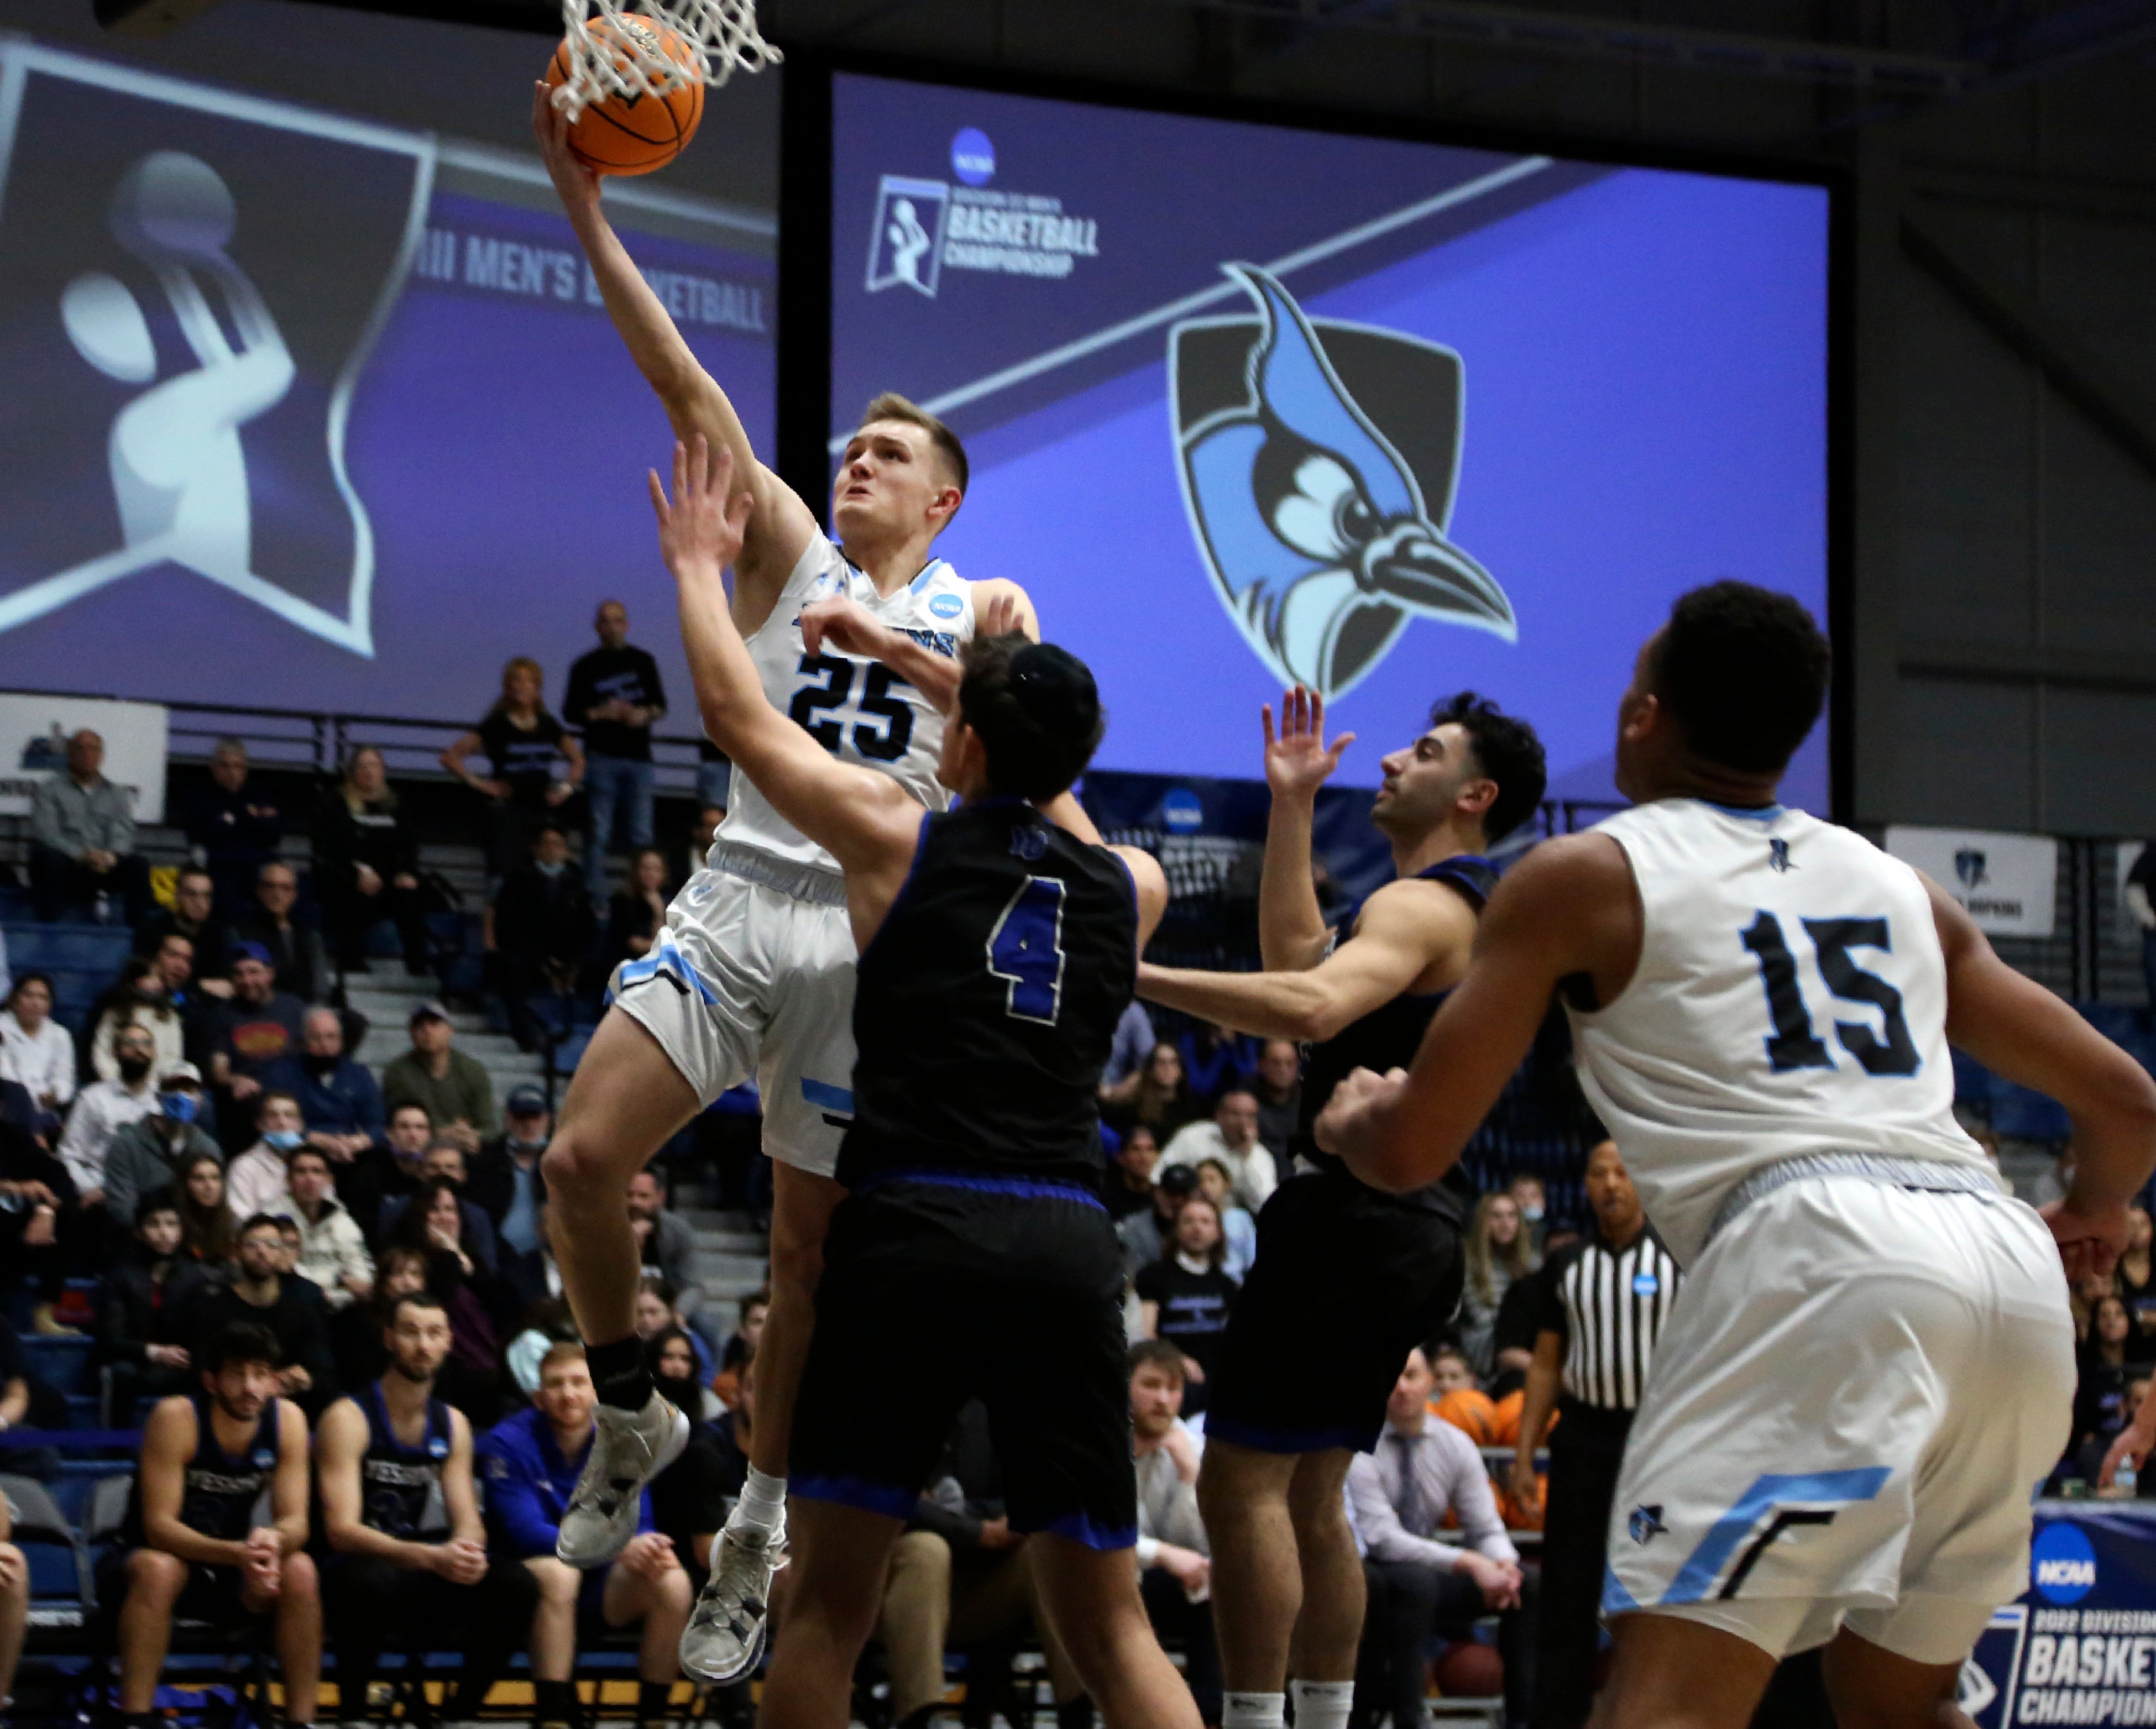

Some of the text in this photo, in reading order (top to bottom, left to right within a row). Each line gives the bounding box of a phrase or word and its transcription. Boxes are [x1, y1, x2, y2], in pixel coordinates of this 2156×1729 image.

[948, 204, 1099, 255] BASKETBALL
[464, 234, 577, 303] MEN'S
[585, 256, 766, 332] BKETBALL
[788, 651, 917, 765] 25
[984, 873, 1067, 1027] 4
[1739, 908, 1924, 1080] 15
[2034, 1609, 2079, 1633] 2022
[2037, 1559, 2096, 1586] NCAA
